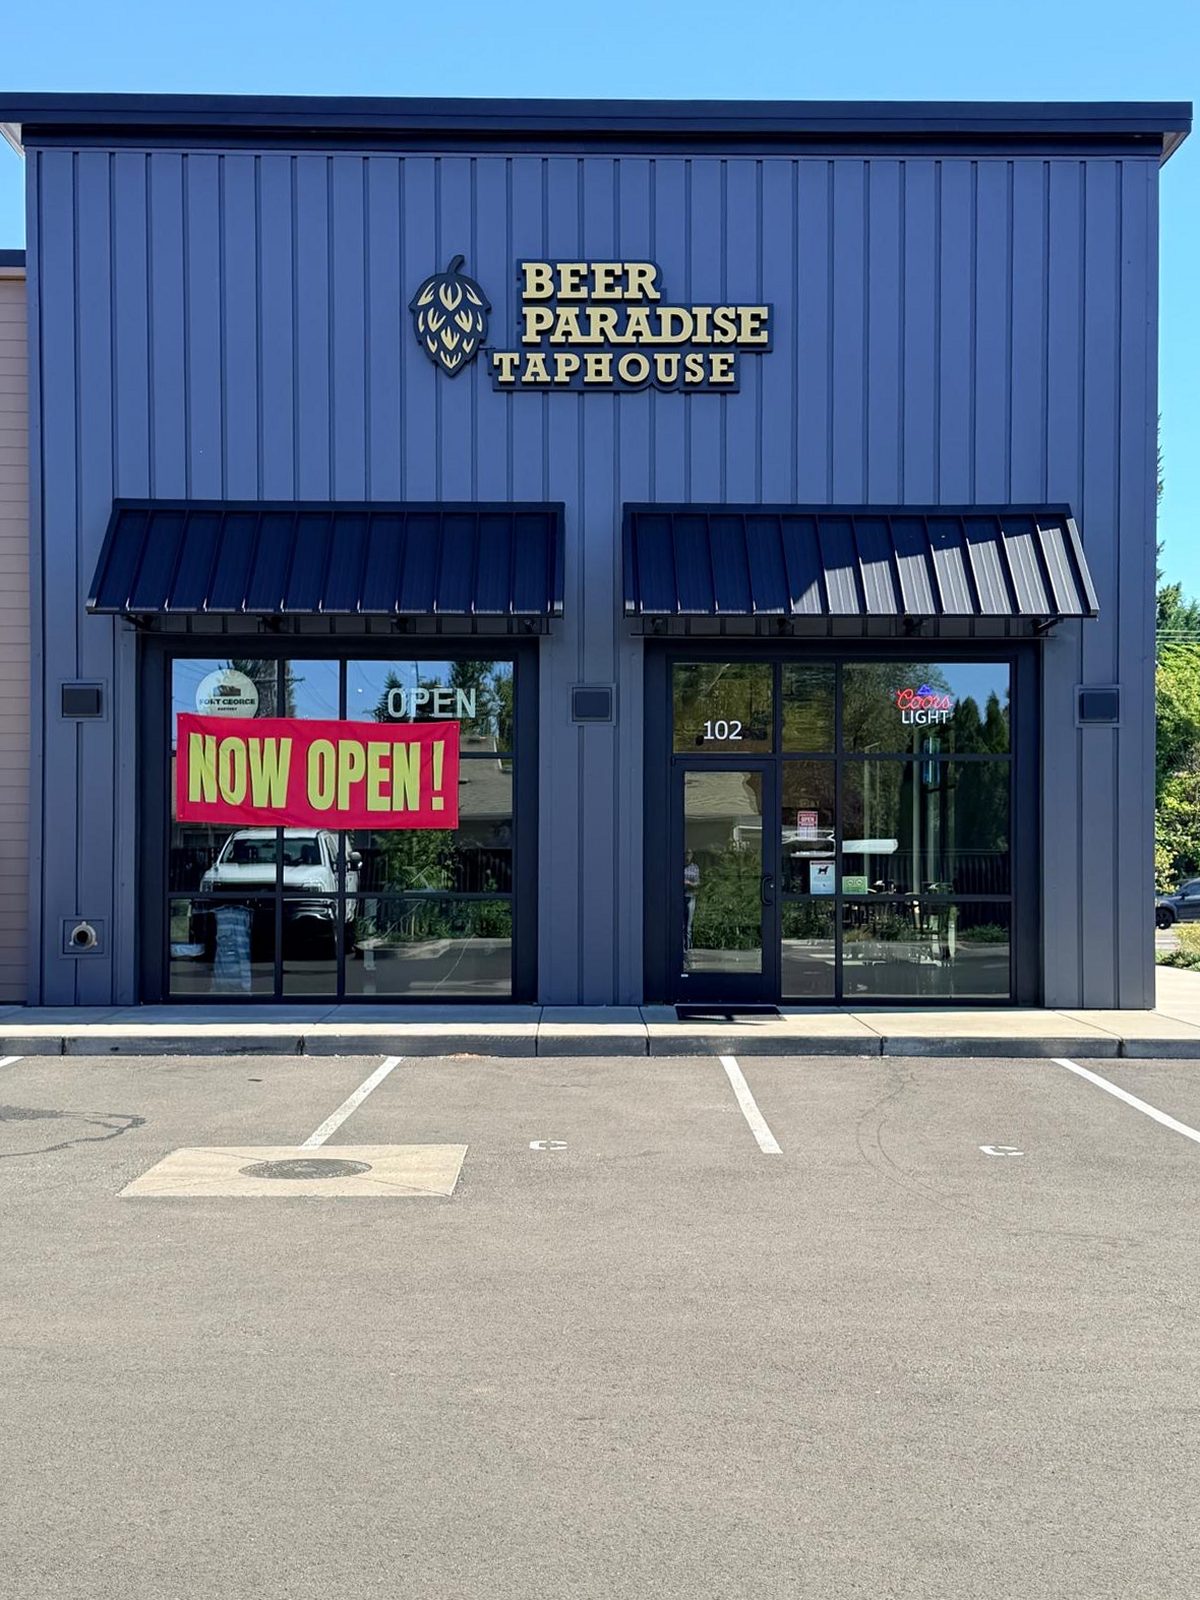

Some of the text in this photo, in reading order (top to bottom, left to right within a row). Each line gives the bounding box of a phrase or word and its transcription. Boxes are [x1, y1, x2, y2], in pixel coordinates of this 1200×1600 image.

[521, 262, 661, 300] BEER
[521, 306, 769, 344] PARADISE
[492, 352, 736, 383] TAPHOUSE
[387, 687, 477, 719] OPEN
[896, 687, 954, 710] Coors
[703, 720, 743, 740] 102
[901, 709, 950, 724] LIGHT
[188, 732, 293, 809] NOW
